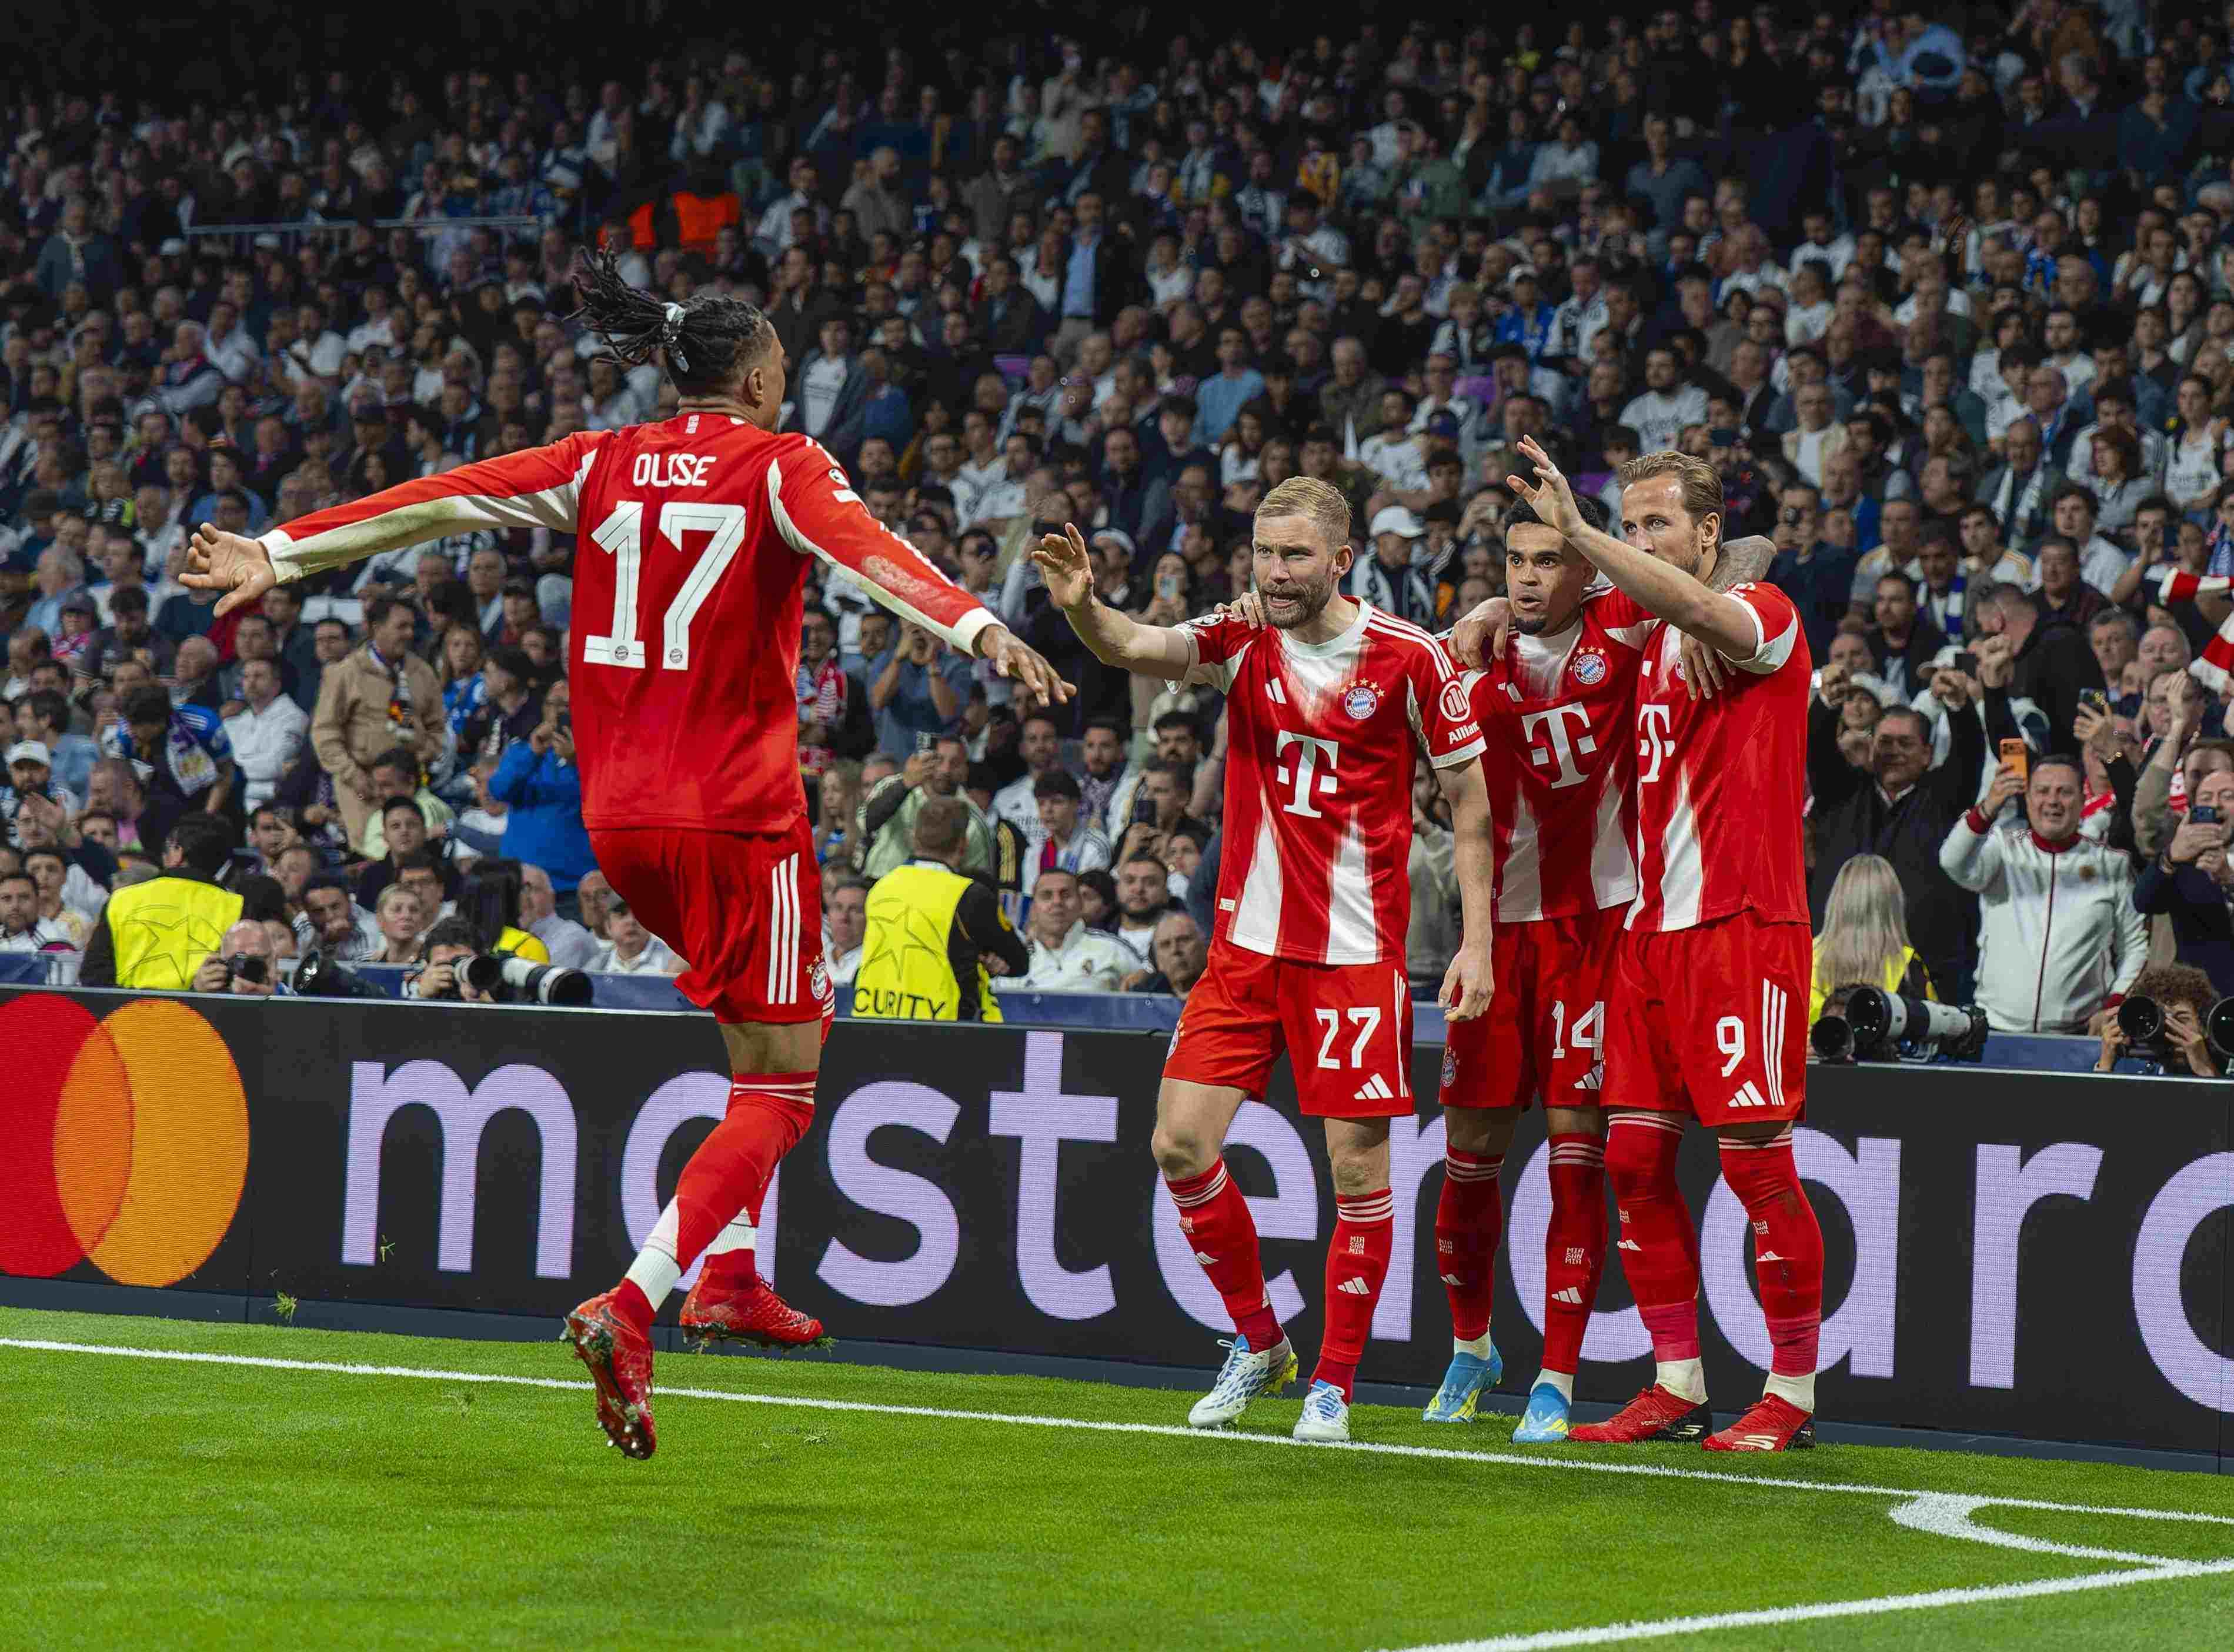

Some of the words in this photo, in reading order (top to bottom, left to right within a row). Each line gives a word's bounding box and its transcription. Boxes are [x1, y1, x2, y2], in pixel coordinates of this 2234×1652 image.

[584, 500, 746, 670] 17
[1277, 730, 1338, 818] T
[1315, 1006, 1381, 1069] 27
[1552, 1000, 1604, 1060] 14
[1716, 1016, 1745, 1077] 9
